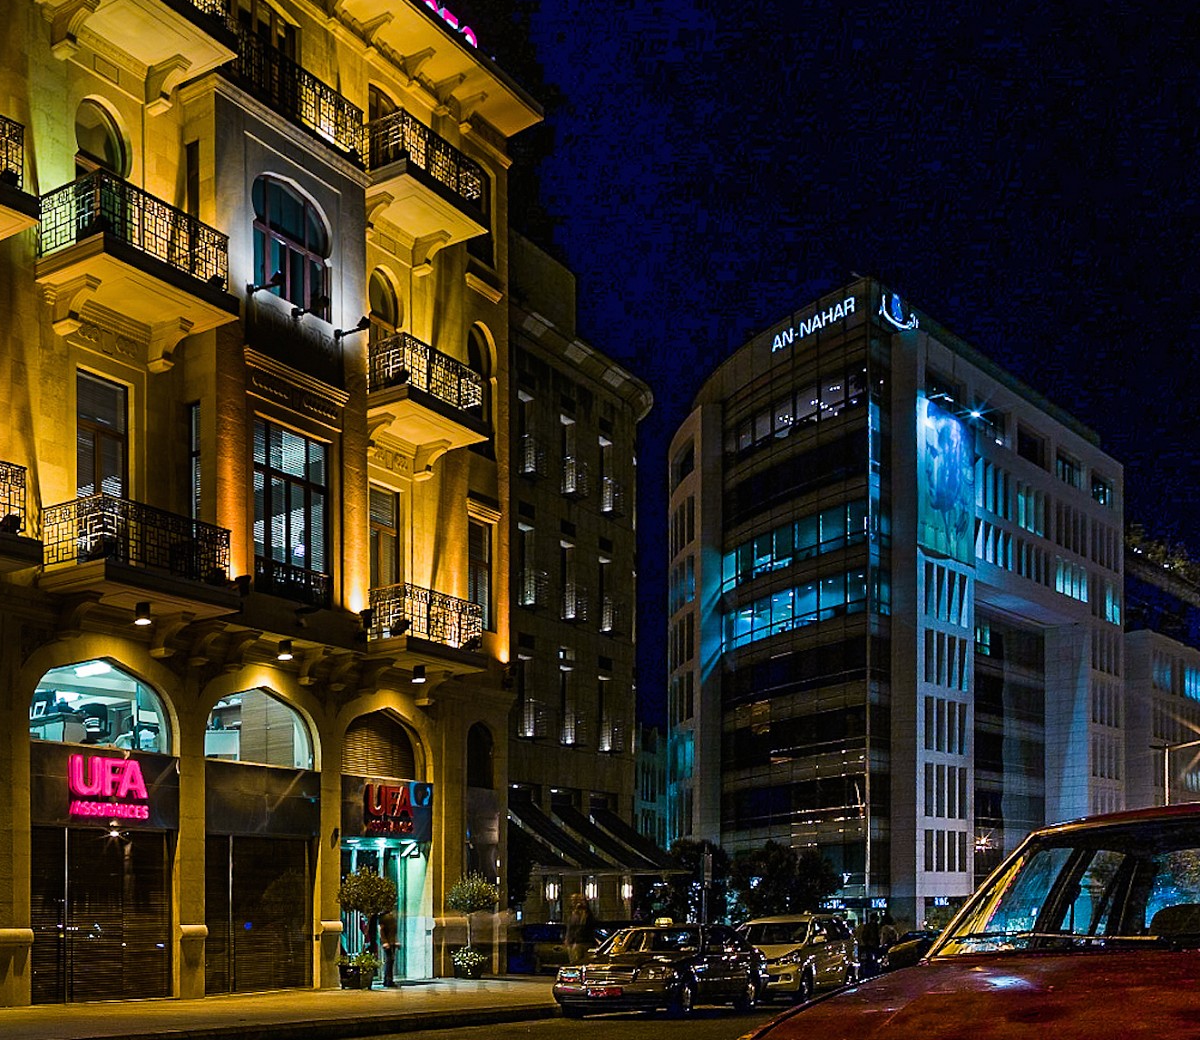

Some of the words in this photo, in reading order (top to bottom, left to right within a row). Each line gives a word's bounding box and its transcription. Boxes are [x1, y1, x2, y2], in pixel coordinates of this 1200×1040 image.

[771, 296, 855, 353] AN-NAHAR
[67, 753, 149, 799] UFA
[365, 783, 414, 819] UFA
